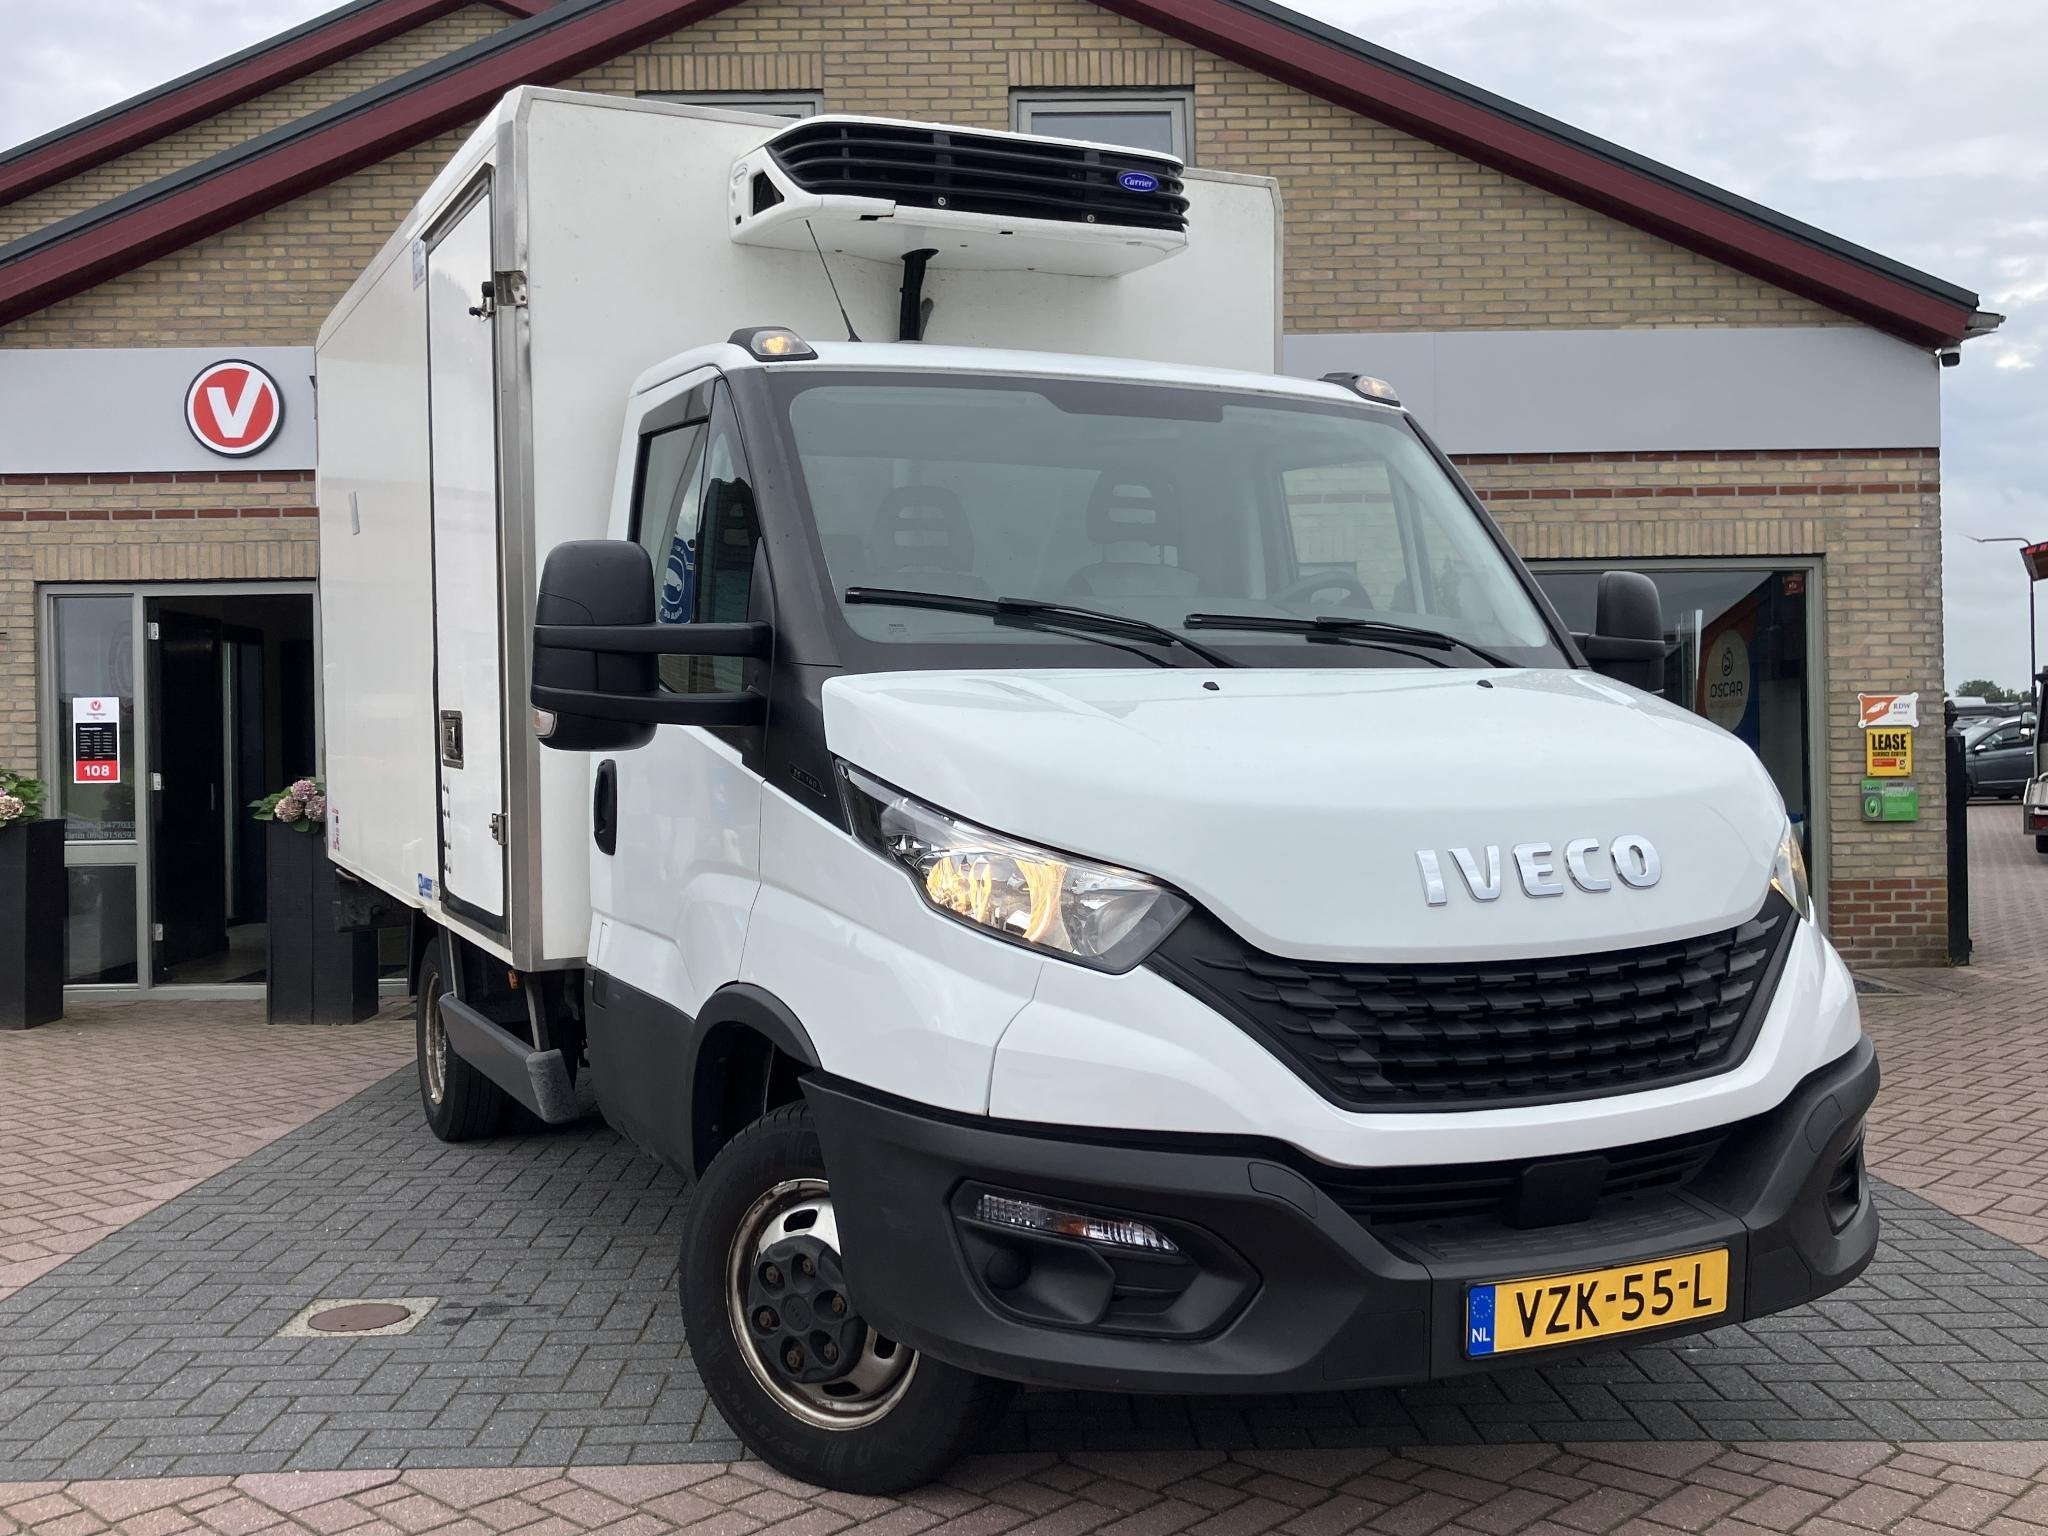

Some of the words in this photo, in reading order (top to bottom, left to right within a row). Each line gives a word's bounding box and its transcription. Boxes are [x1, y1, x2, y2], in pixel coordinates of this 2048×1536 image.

[1124, 176, 1153, 188] Carrier
[206, 368, 265, 439] V
[1710, 680, 1743, 698] OSCAR
[1893, 702, 1911, 710] RDW
[1872, 733, 1907, 751] LEASE
[84, 764, 110, 777] 108
[1415, 834, 1662, 906] IVECO
[1515, 1263, 1712, 1338] VZK-55-L
[1471, 1327, 1491, 1343] NL
